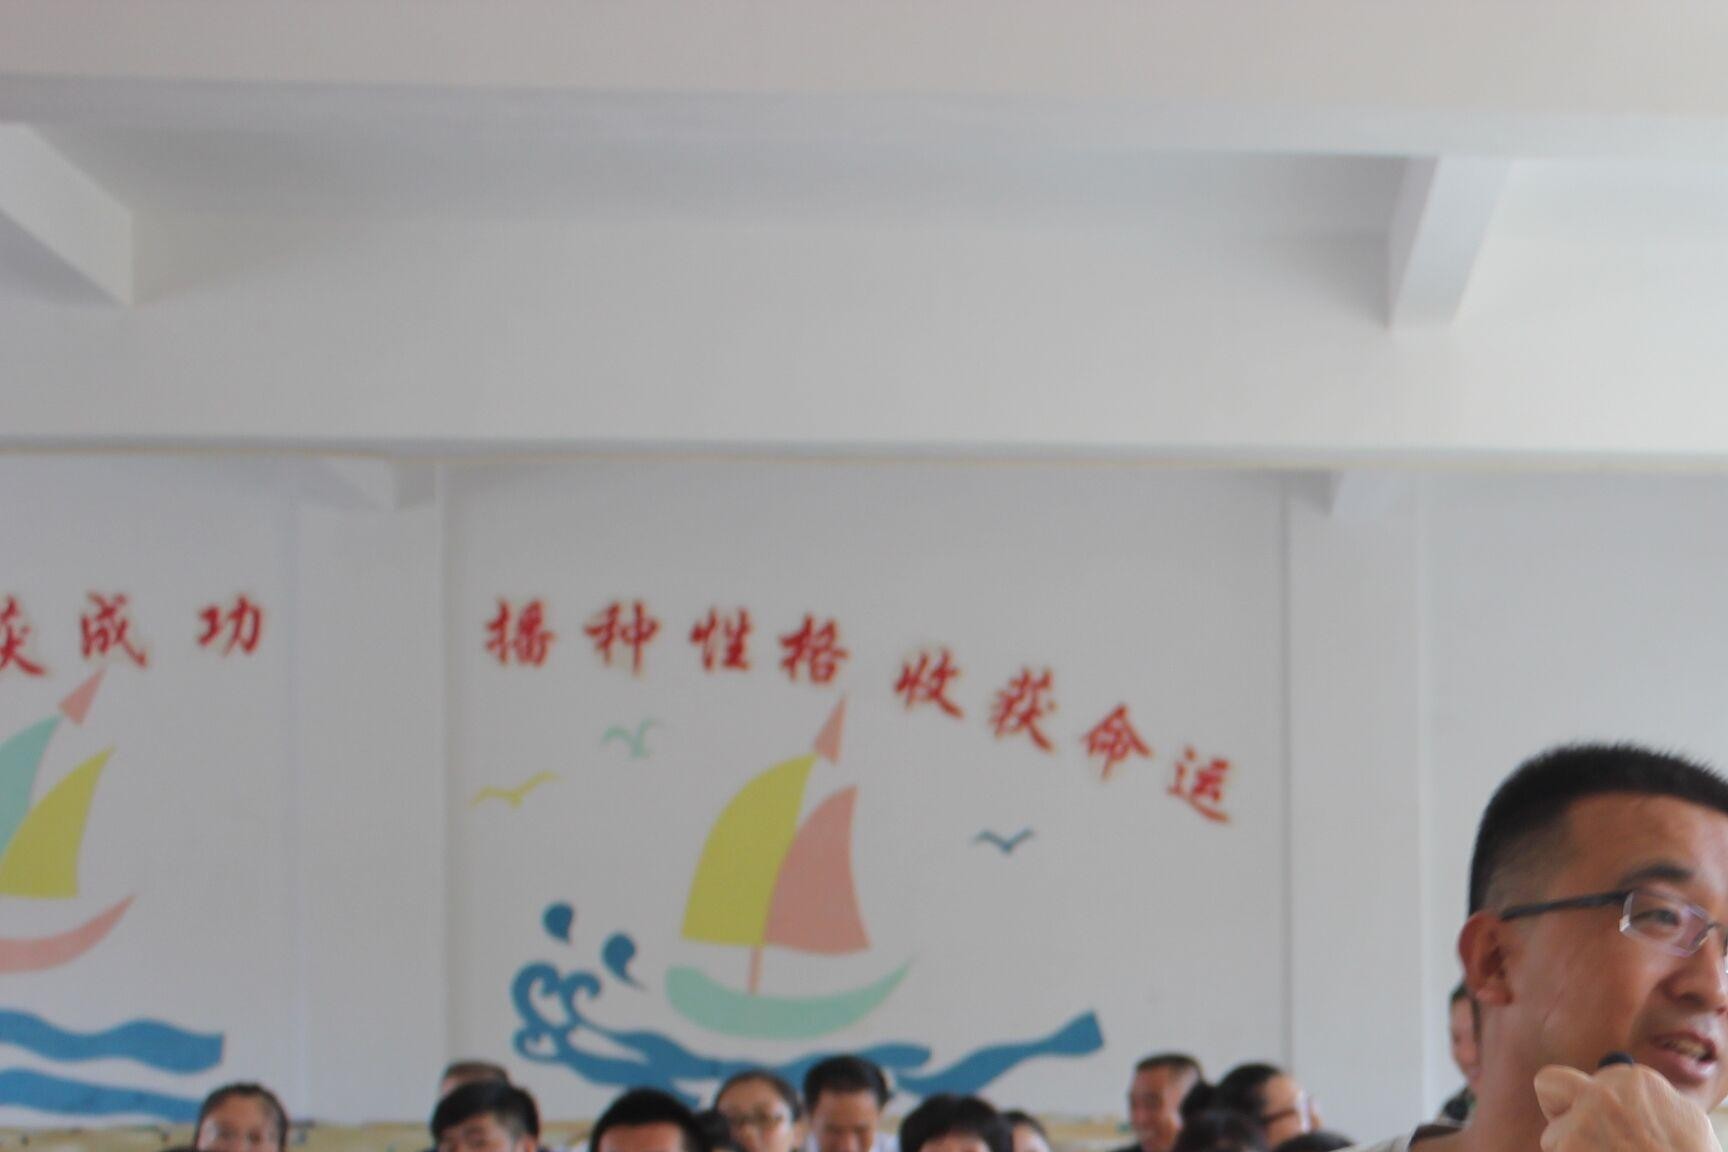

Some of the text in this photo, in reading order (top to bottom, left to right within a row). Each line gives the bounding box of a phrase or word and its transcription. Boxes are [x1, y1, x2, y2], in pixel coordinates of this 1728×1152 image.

[484, 596, 1233, 824] 播种性格 收获命运
